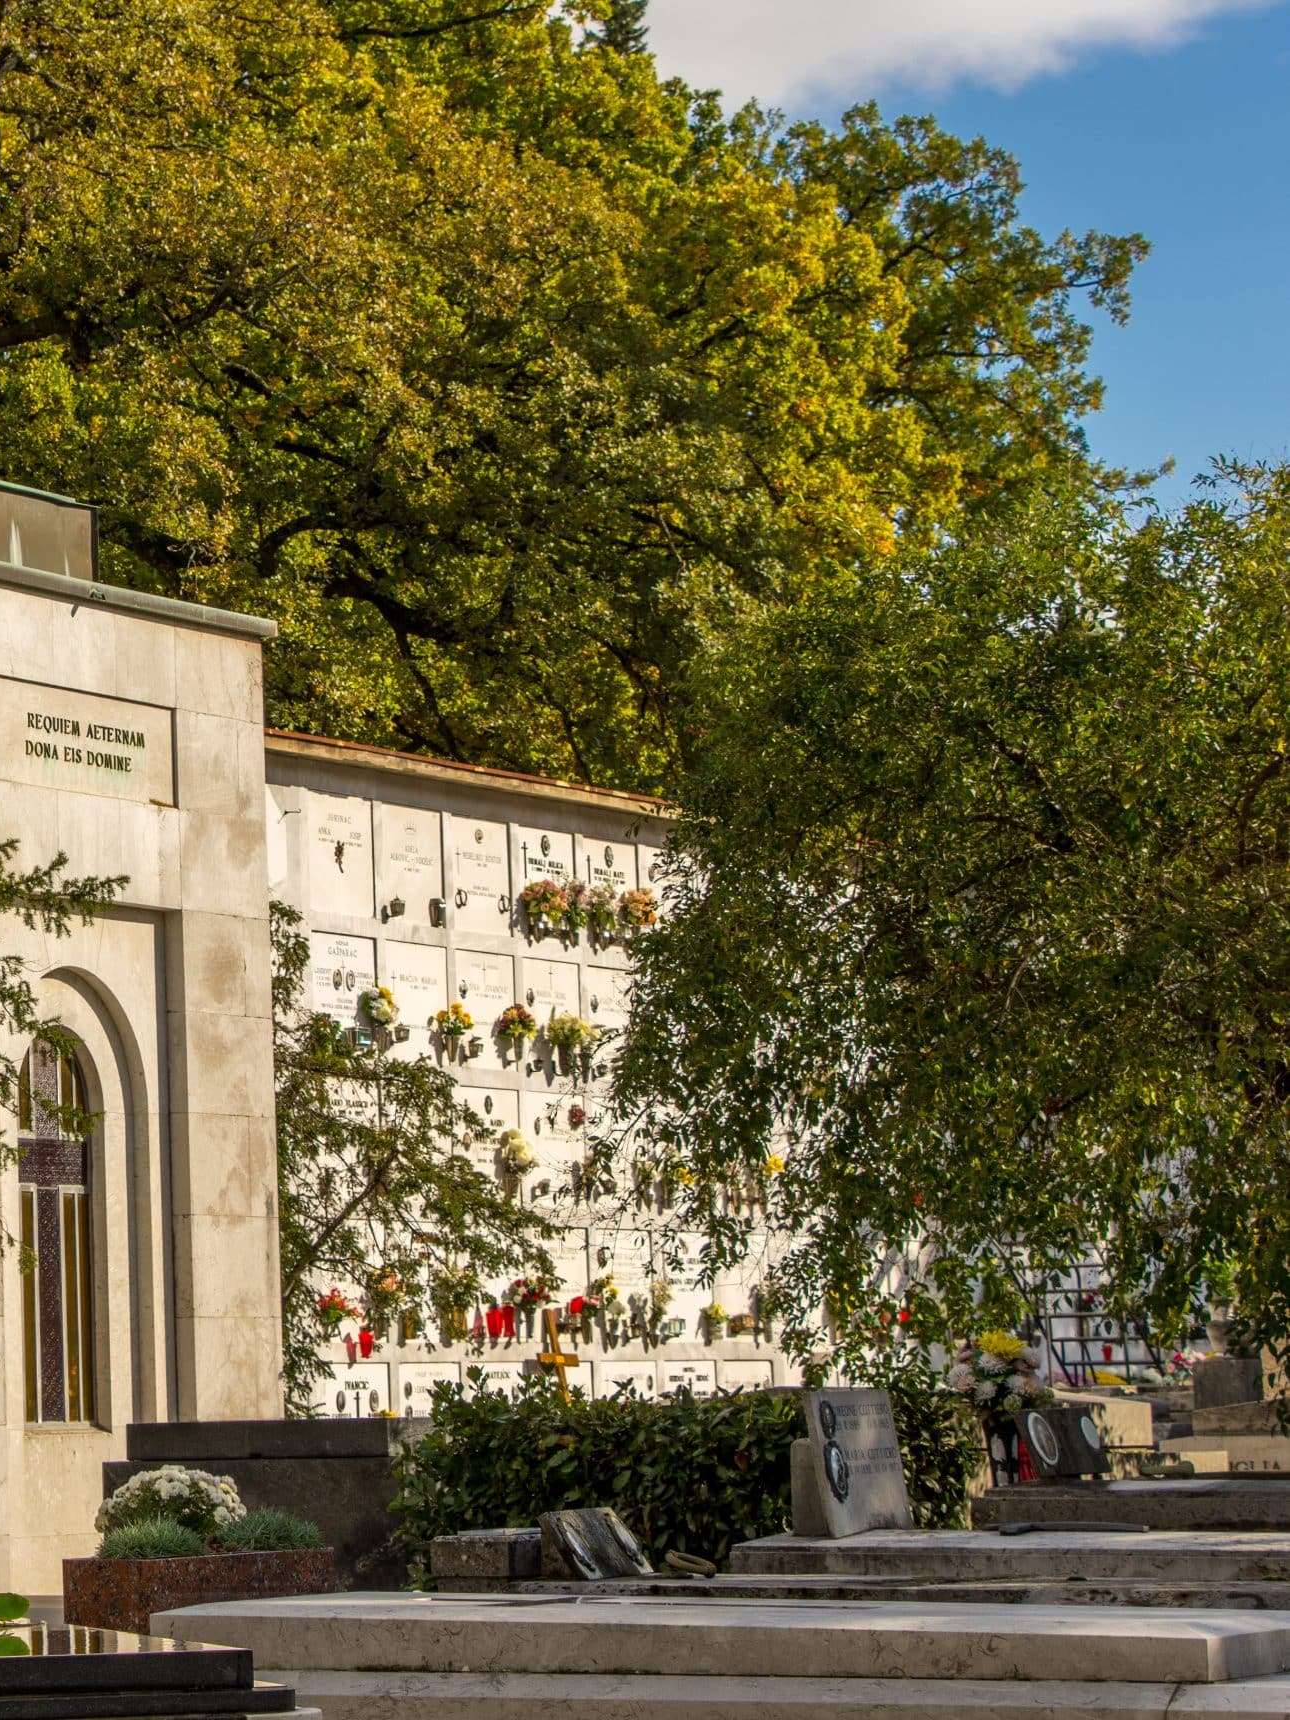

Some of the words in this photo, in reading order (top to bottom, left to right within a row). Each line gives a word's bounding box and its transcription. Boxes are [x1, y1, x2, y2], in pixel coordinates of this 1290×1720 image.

[27, 711, 81, 737] REQUIEM
[86, 723, 146, 748] AETERNAM
[25, 740, 59, 760] DONA
[63, 746, 83, 764] EIS
[86, 750, 133, 772] DOMINE
